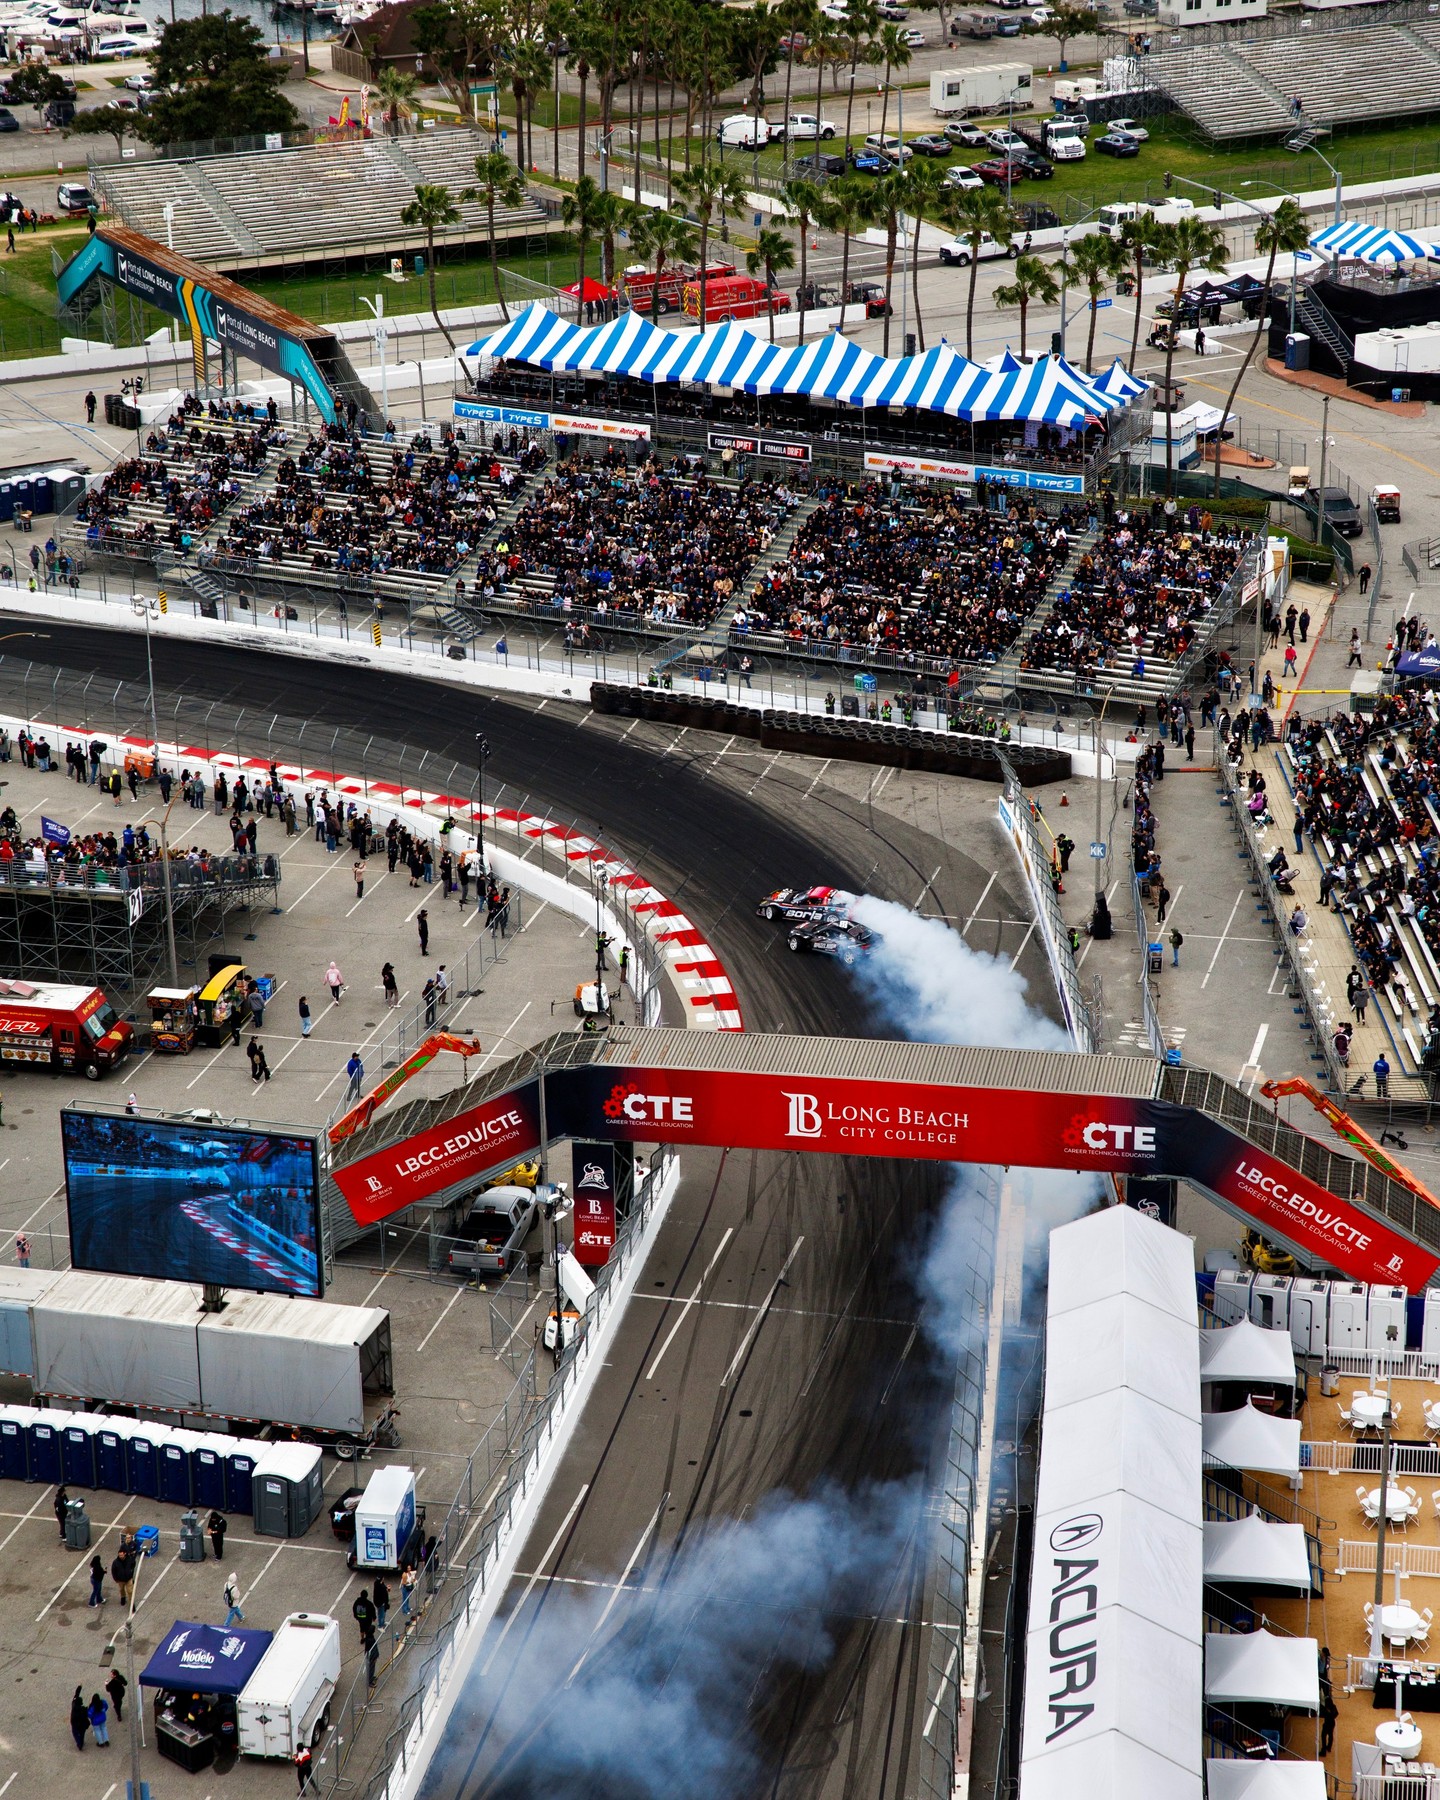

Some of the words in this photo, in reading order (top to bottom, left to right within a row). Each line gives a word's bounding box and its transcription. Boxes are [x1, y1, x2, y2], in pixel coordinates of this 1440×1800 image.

[1127, 59, 1135, 73] 27
[128, 260, 137, 274] Port
[142, 269, 156, 284] LONG
[156, 276, 173, 293] BEACH
[226, 314, 238, 327] Port
[242, 322, 258, 341] LONG
[258, 332, 277, 349] BEACH
[226, 329, 234, 339] THE
[570, 420, 599, 430] AutoZone
[619, 427, 647, 437] AutoZone
[714, 438, 736, 450] FORMULA
[736, 439, 752, 450] DRIFT
[764, 445, 786, 454] FORMULA
[786, 447, 803, 457] DRIFT
[938, 466, 969, 476] AutoZone
[1090, 846, 1104, 856] KK
[131, 887, 141, 922] 21
[622, 1093, 694, 1121] CTE
[395, 1110, 522, 1177] LBCC.EDU/CTE
[840, 1126, 876, 1138] CITY
[884, 1130, 957, 1144] COLLEGE
[1082, 1122, 1156, 1152] CTE
[412, 1166, 440, 1182] CAREER
[440, 1148, 480, 1171] TECHNICAL
[479, 1130, 520, 1153] EDUCATION
[1235, 1161, 1372, 1251] LBCC.EDU/CTE
[1237, 1182, 1268, 1204] CAREER
[1267, 1198, 1308, 1228] TECHNICAL
[1308, 1224, 1353, 1254] EDUCATION
[586, 1234, 612, 1245] CTE
[181, 1650, 214, 1664] Modelo
[220, 1636, 240, 1658] Modelo
[1045, 1558, 1099, 1744] ACURA
